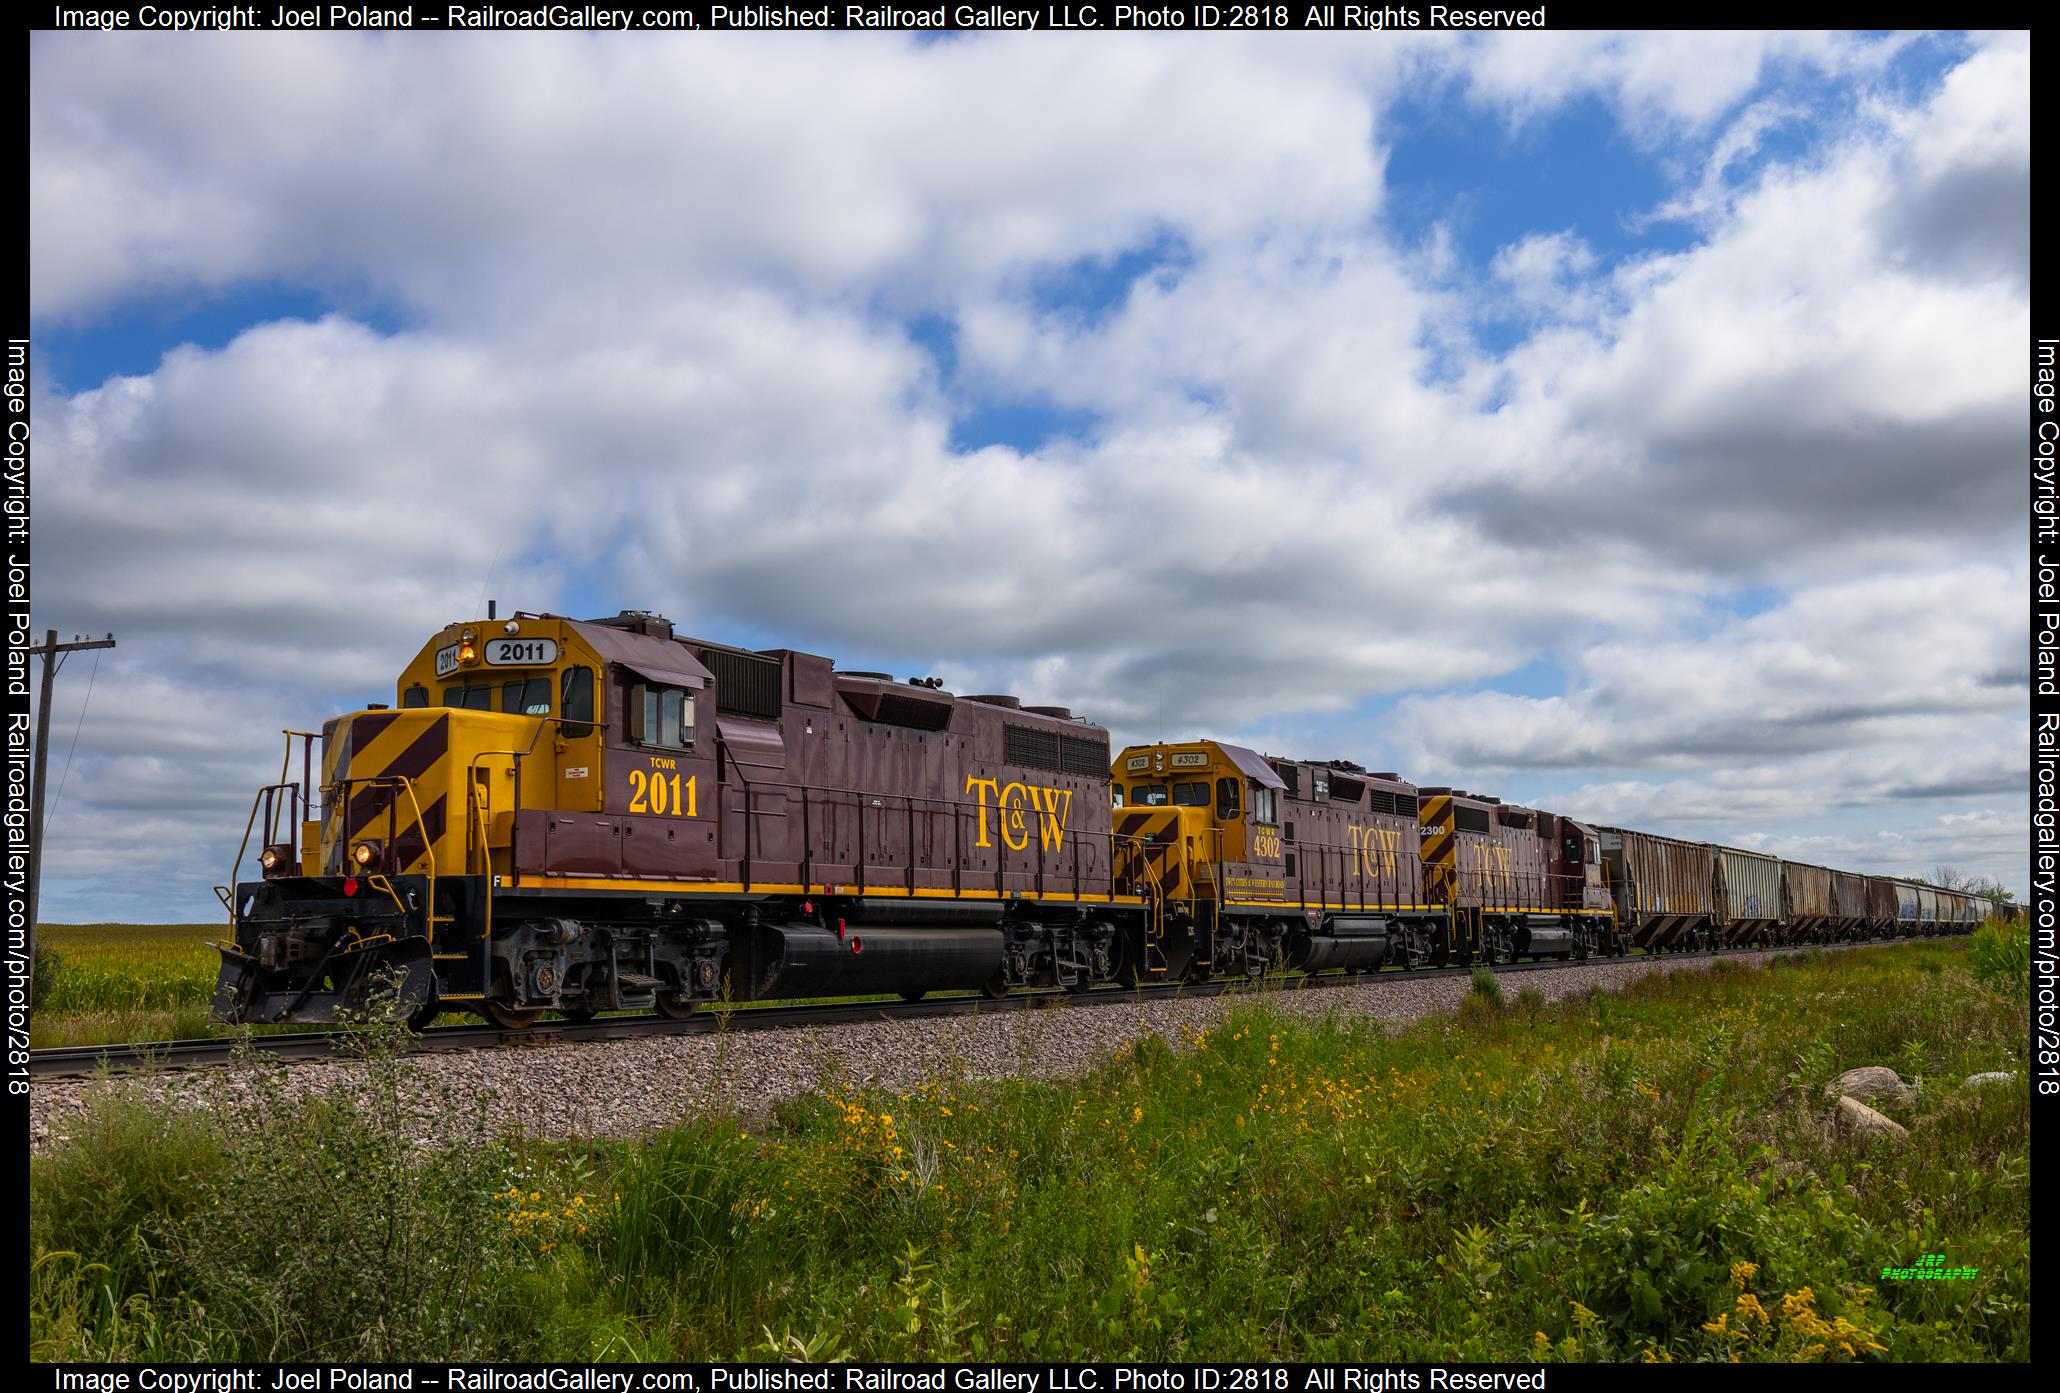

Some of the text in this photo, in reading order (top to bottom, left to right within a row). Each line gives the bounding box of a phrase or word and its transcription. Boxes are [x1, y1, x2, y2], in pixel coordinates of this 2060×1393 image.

[500, 643, 544, 660] 2011
[650, 757, 676, 769] TCWR
[1177, 755, 1199, 764] 4302
[629, 769, 697, 817] 2011
[1420, 826, 1445, 835] 2300
[1254, 835, 1280, 858] 4302
[493, 875, 501, 887] F
